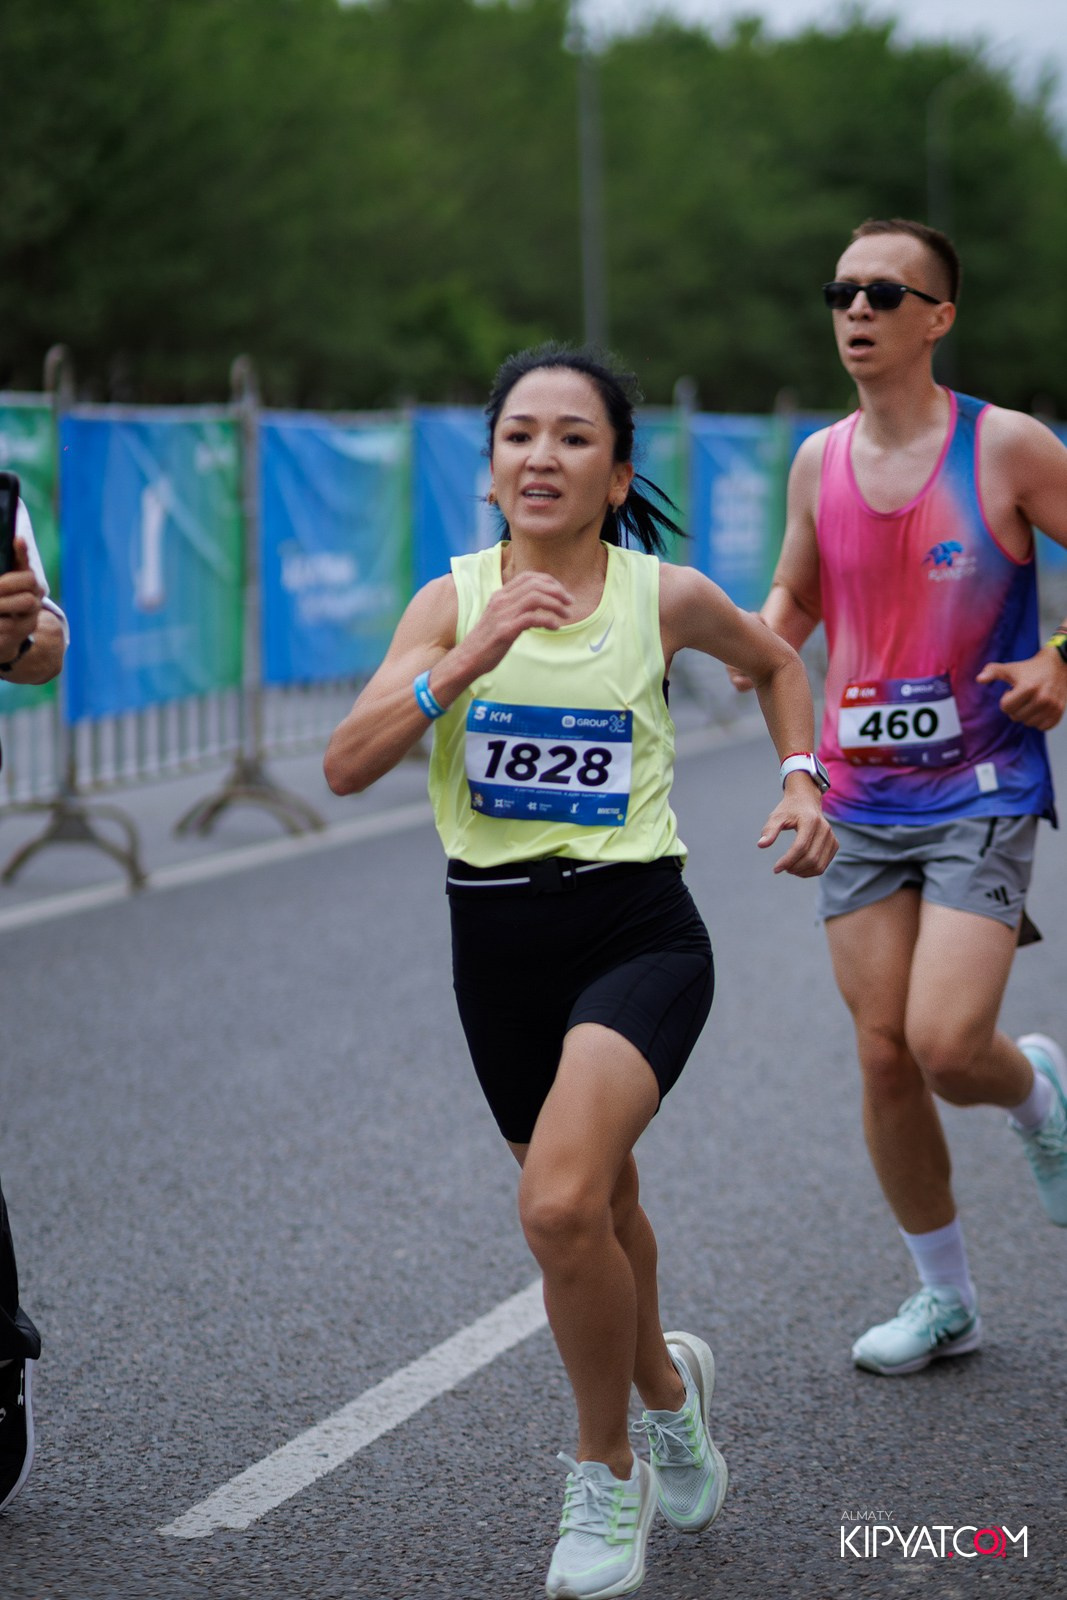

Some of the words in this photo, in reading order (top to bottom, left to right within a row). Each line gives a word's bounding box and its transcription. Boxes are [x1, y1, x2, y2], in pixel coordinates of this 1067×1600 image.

[473, 705, 488, 720] 5
[489, 711, 513, 723] KM
[576, 718, 609, 728] GROUP
[859, 707, 939, 741] 460
[484, 740, 613, 787] 1828
